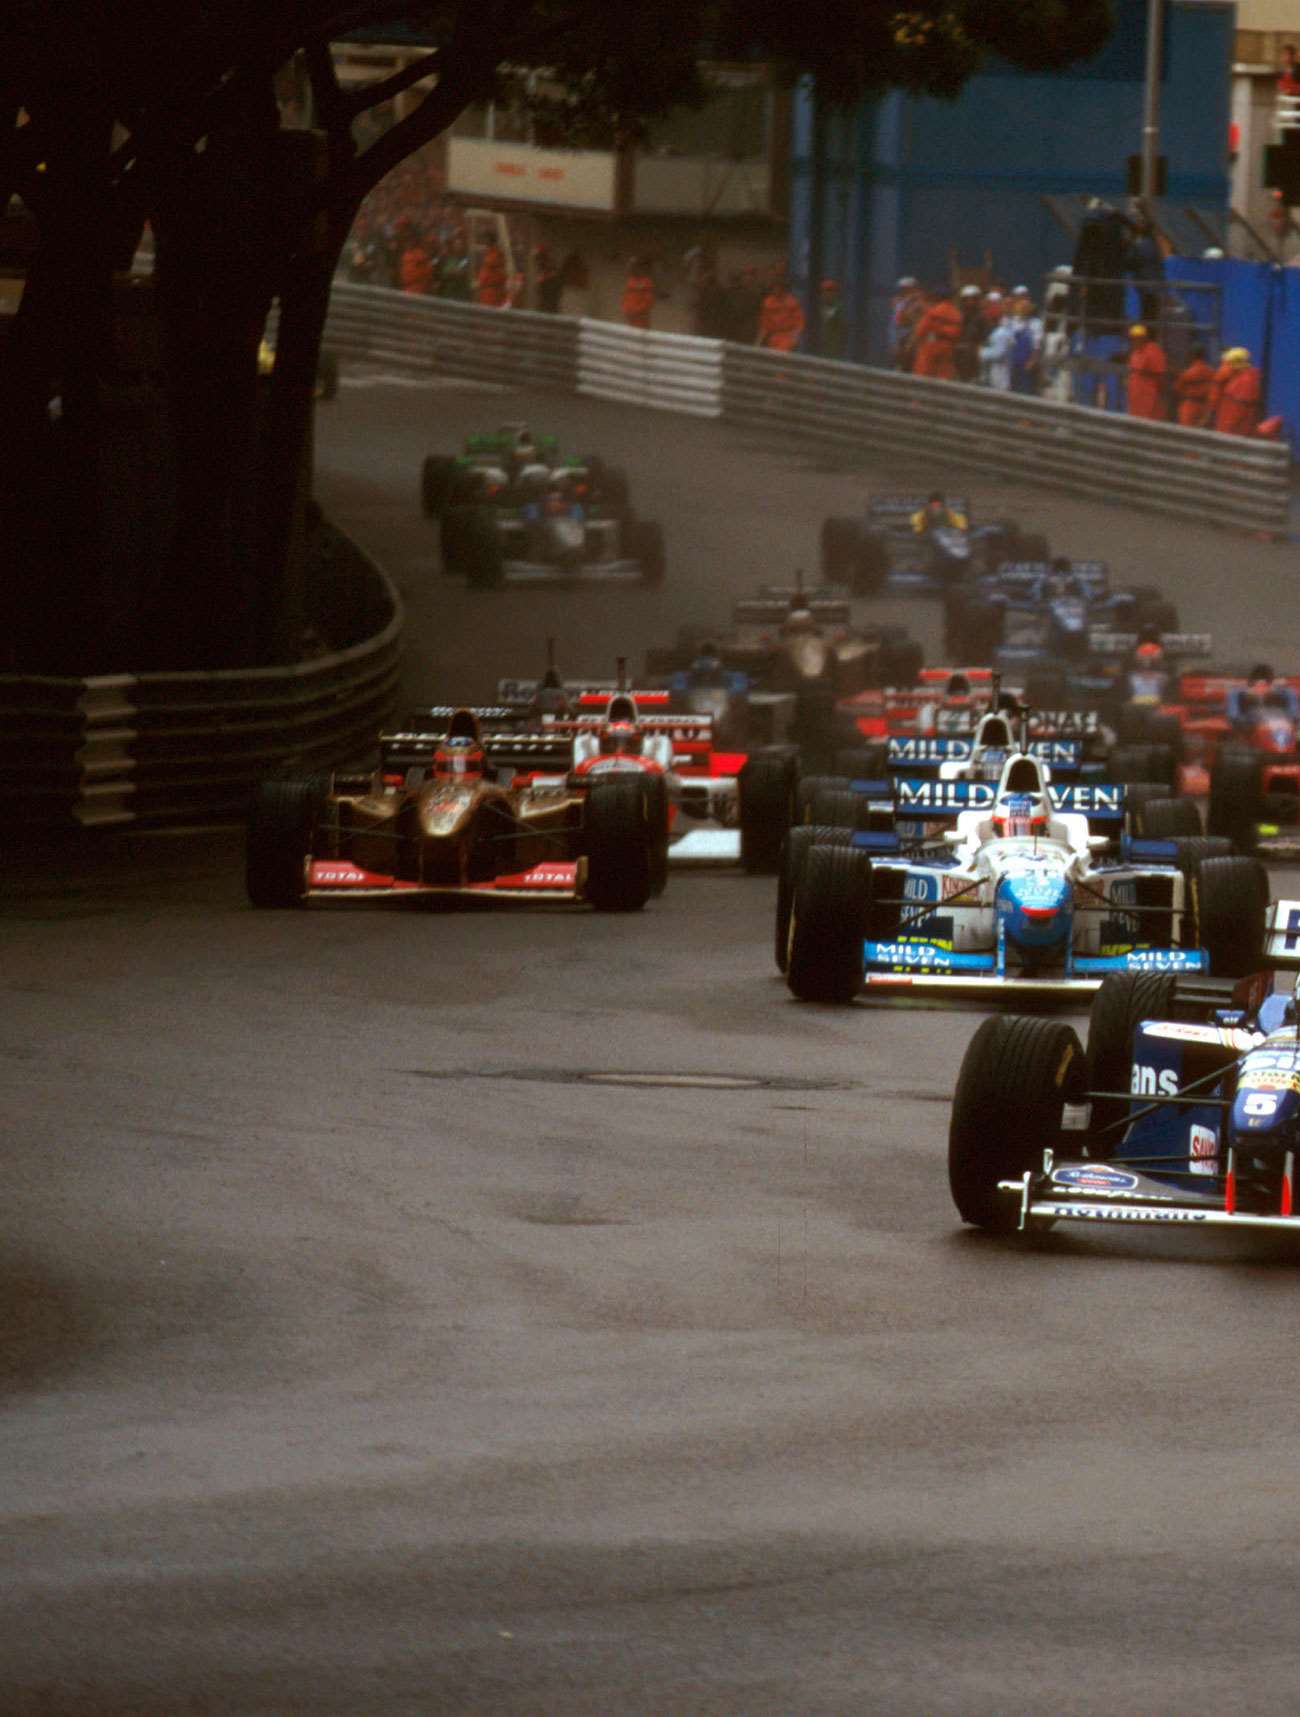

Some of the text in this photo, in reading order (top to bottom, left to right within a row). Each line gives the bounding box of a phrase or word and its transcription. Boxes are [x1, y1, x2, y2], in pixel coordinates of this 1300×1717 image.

[888, 738, 970, 760] MILD
[900, 781, 995, 807] MILD
[876, 943, 937, 956] MILD
[1127, 951, 1187, 962] MILD
[1243, 1093, 1277, 1116] 5
